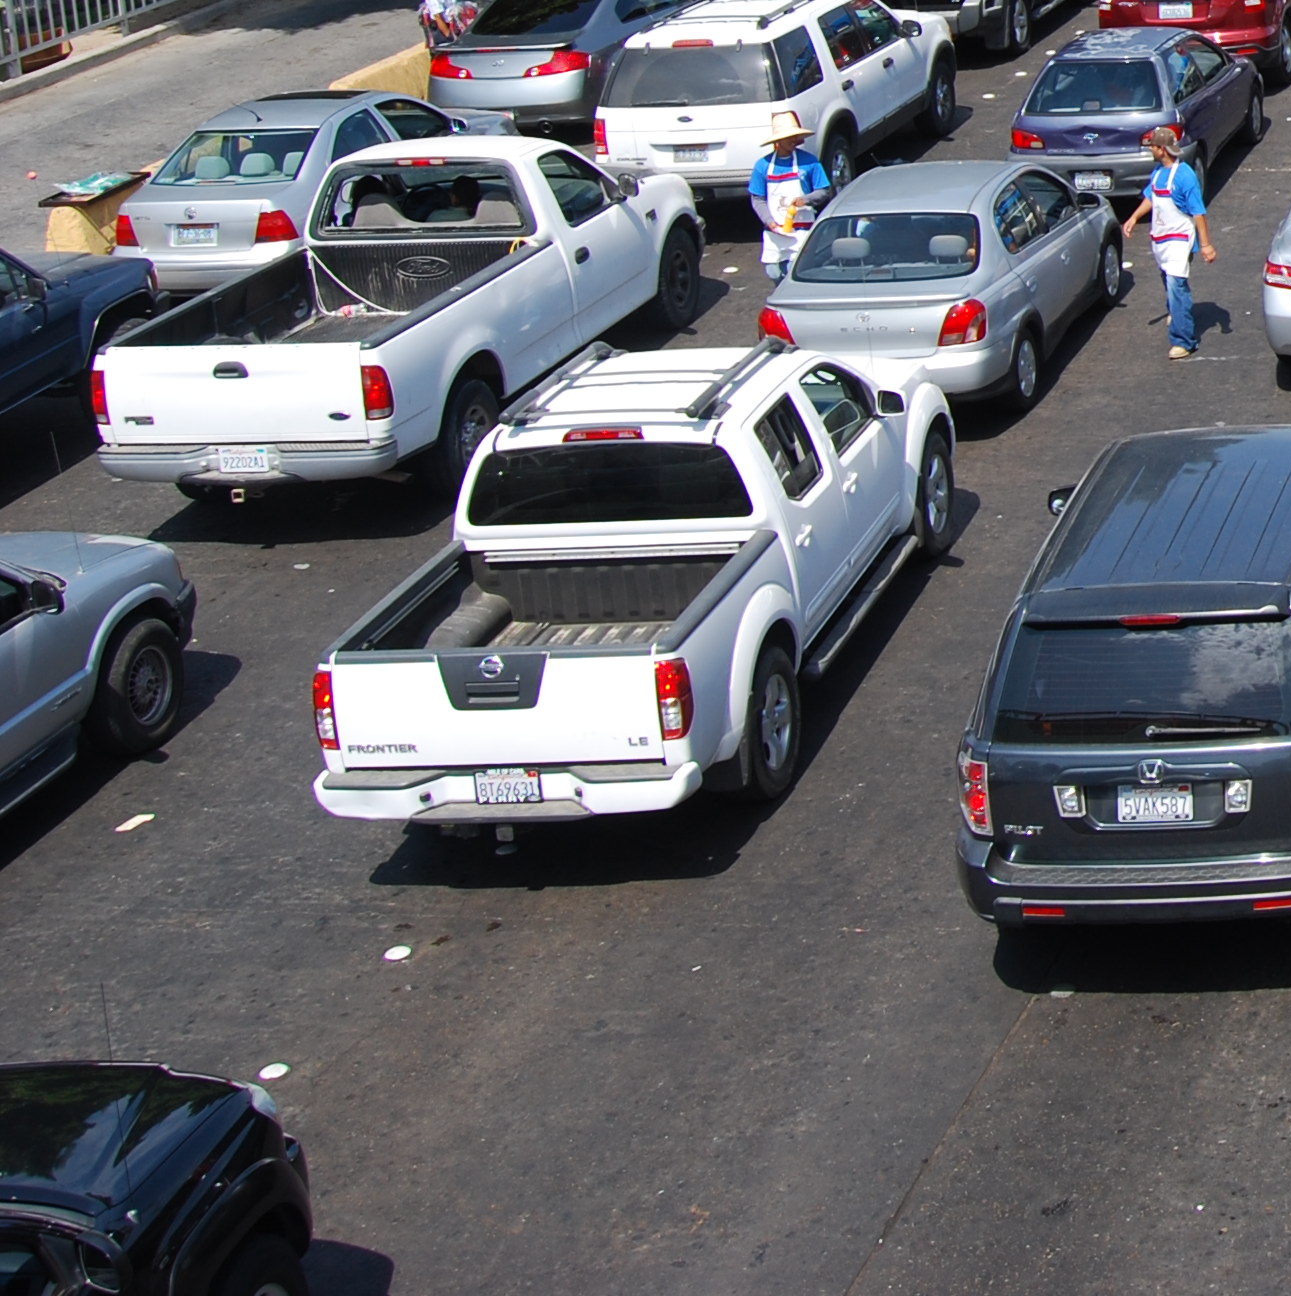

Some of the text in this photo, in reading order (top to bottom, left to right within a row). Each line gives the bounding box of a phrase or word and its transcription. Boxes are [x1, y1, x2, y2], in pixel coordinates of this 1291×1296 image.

[223, 455, 265, 469] 92202A1
[348, 743, 418, 754] FRONTIER
[628, 736, 649, 747] LE
[479, 781, 537, 798] 8T69631
[1124, 796, 1187, 816] 5VAK587
